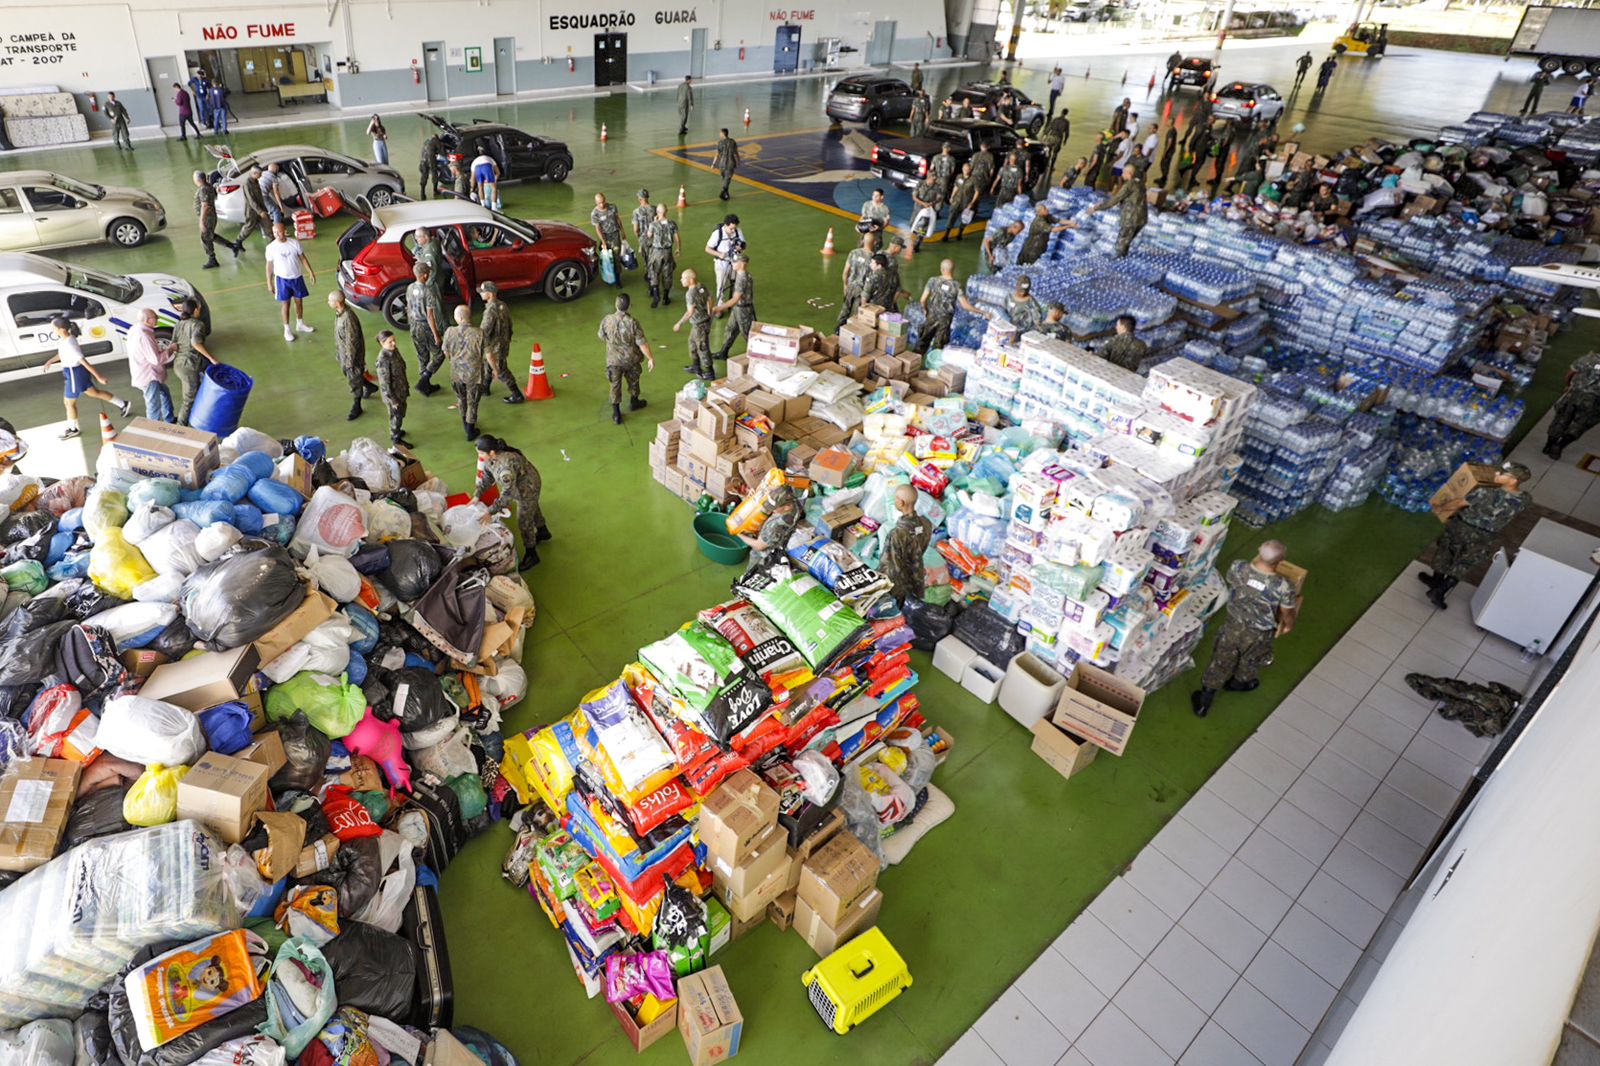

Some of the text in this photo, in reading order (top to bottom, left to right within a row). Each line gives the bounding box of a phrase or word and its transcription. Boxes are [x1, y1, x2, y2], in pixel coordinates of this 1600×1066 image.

[550, 7, 698, 30] ESQUADRÃO GUARÁ
[769, 8, 816, 21] NÃO FUME
[61, 32, 76, 41] DA
[202, 22, 296, 41] NÃO FUME
[4, 43, 78, 55] TRANSPORTE
[32, 55, 64, 65] 2007
[837, 568, 879, 590] Chanin
[748, 639, 793, 666] Chanin
[728, 686, 753, 714] Dog
[727, 693, 761, 730] LOVE
